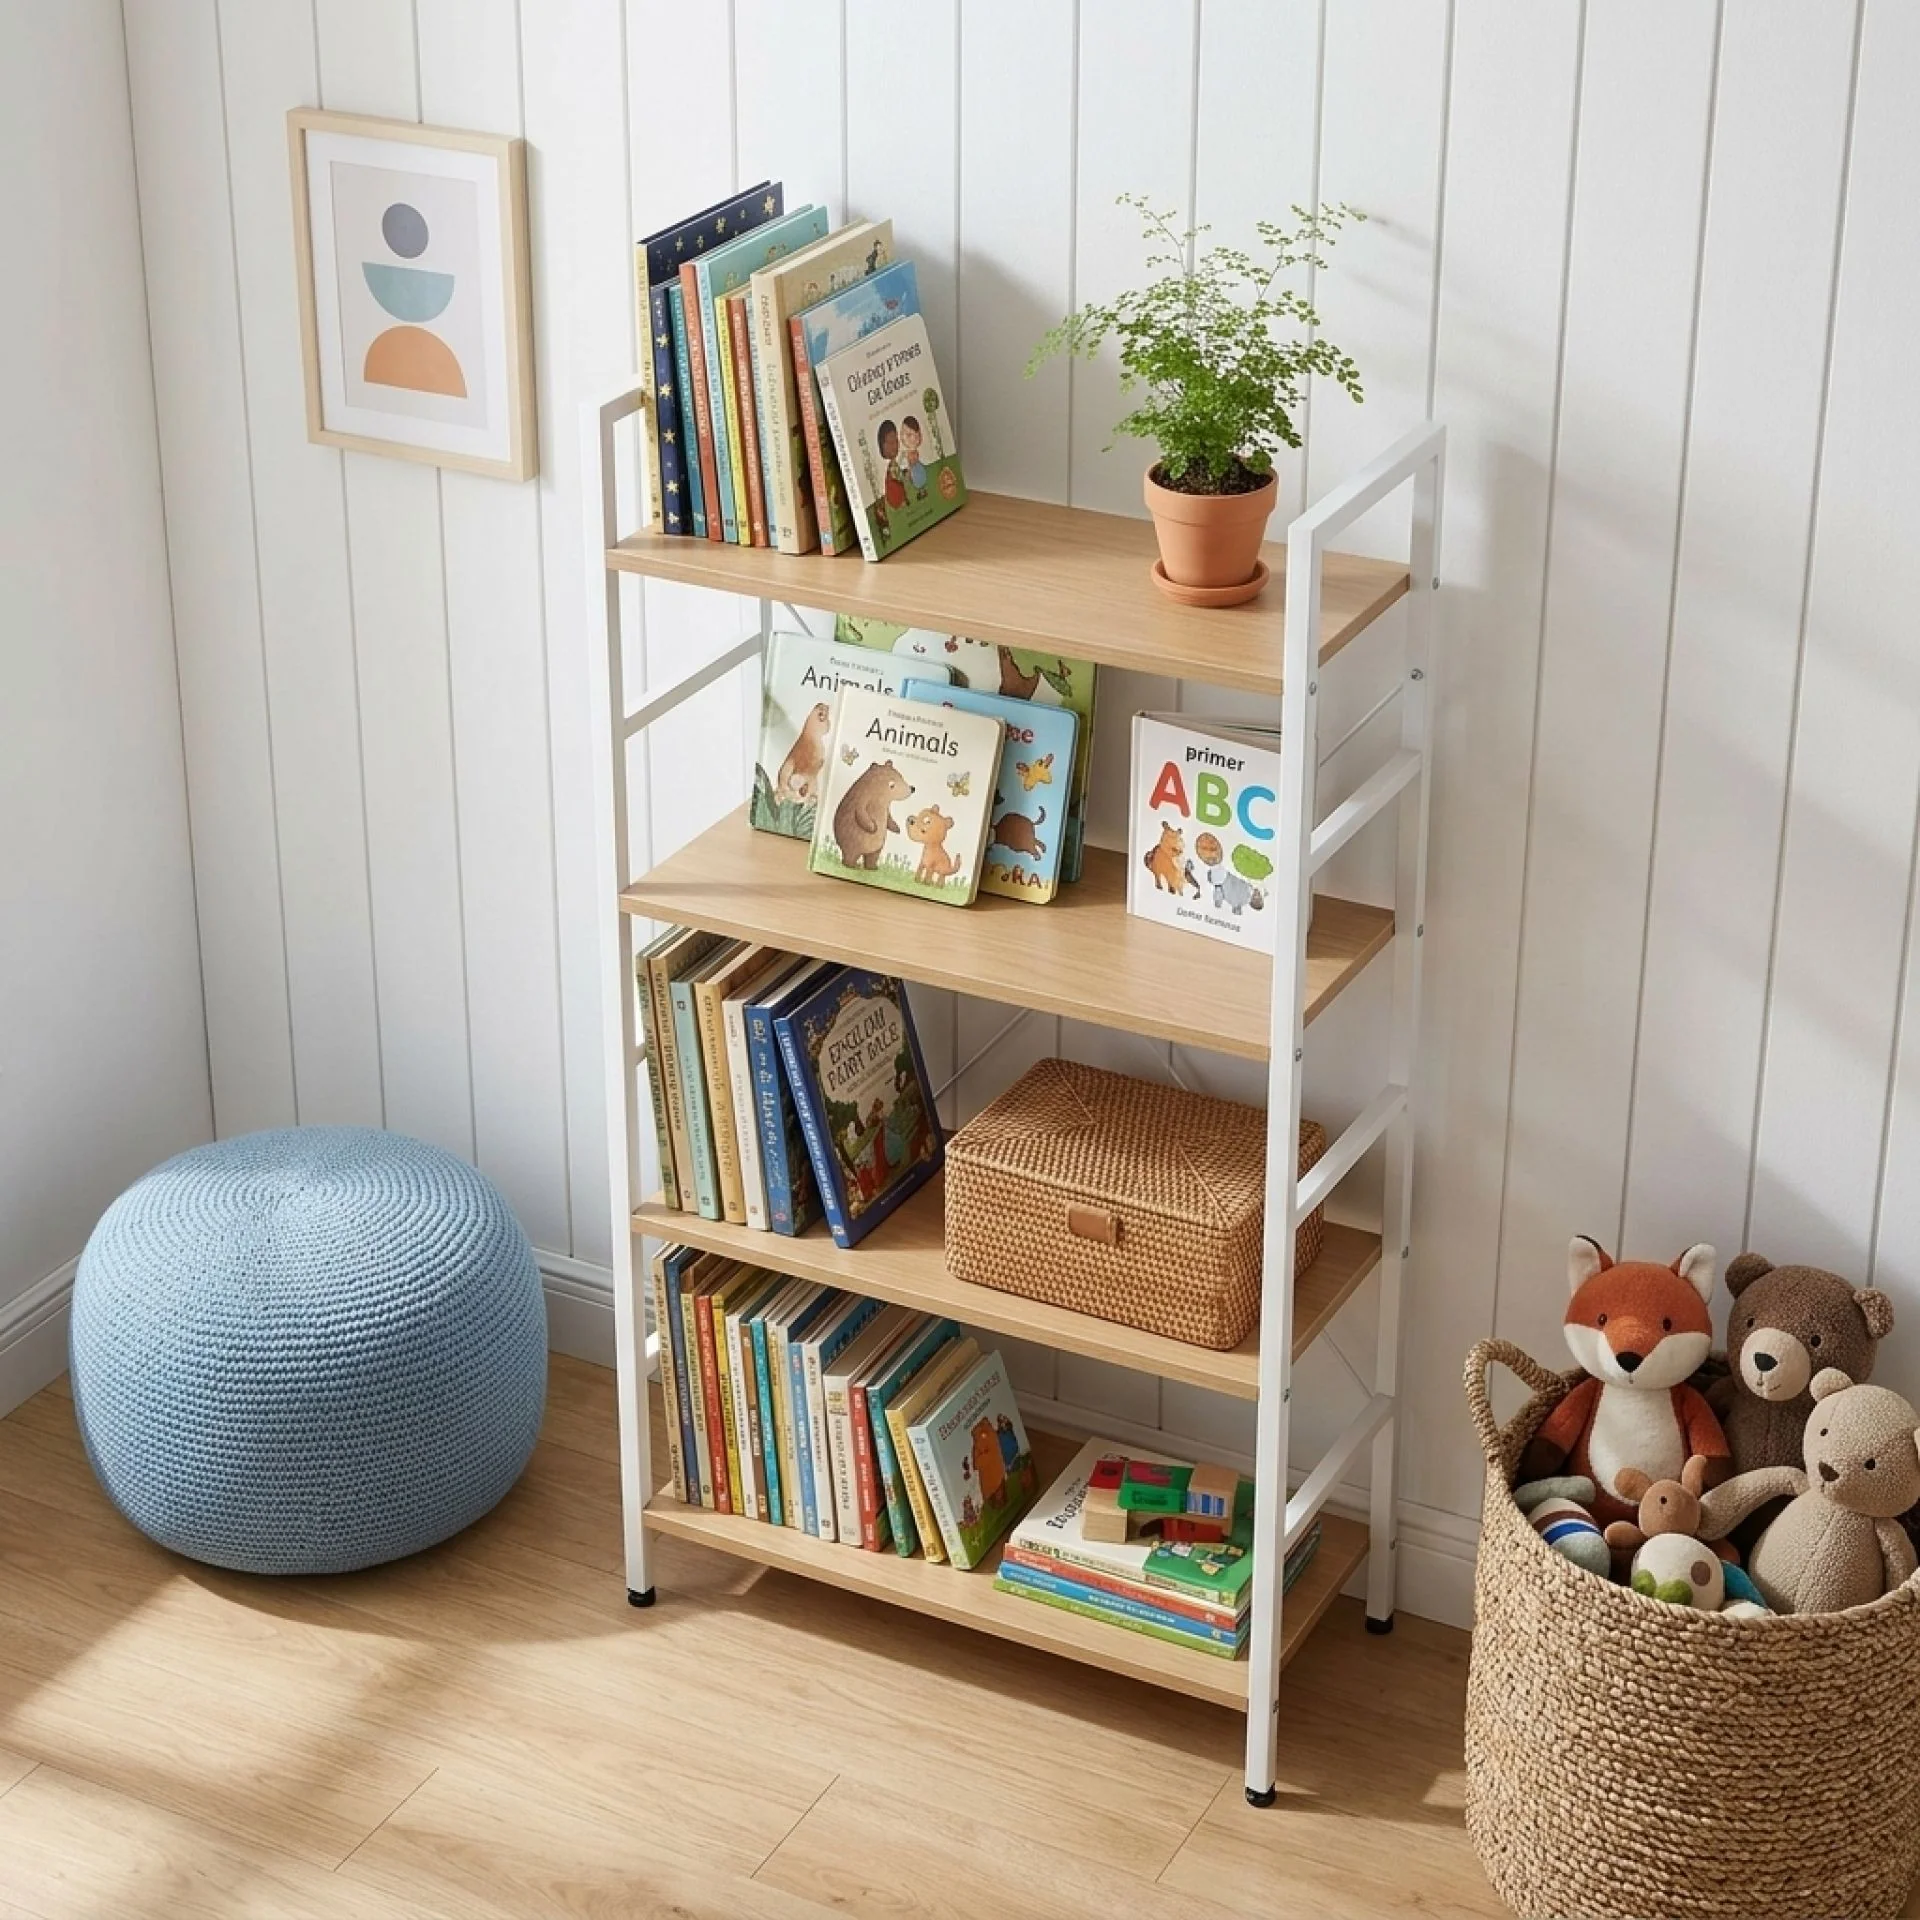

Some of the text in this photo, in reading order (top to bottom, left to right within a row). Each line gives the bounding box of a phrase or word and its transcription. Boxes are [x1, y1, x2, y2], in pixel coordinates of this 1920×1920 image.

[866, 717, 959, 757] Animals
[1186, 746, 1245, 771] primer
[1149, 761, 1275, 841] ABC
